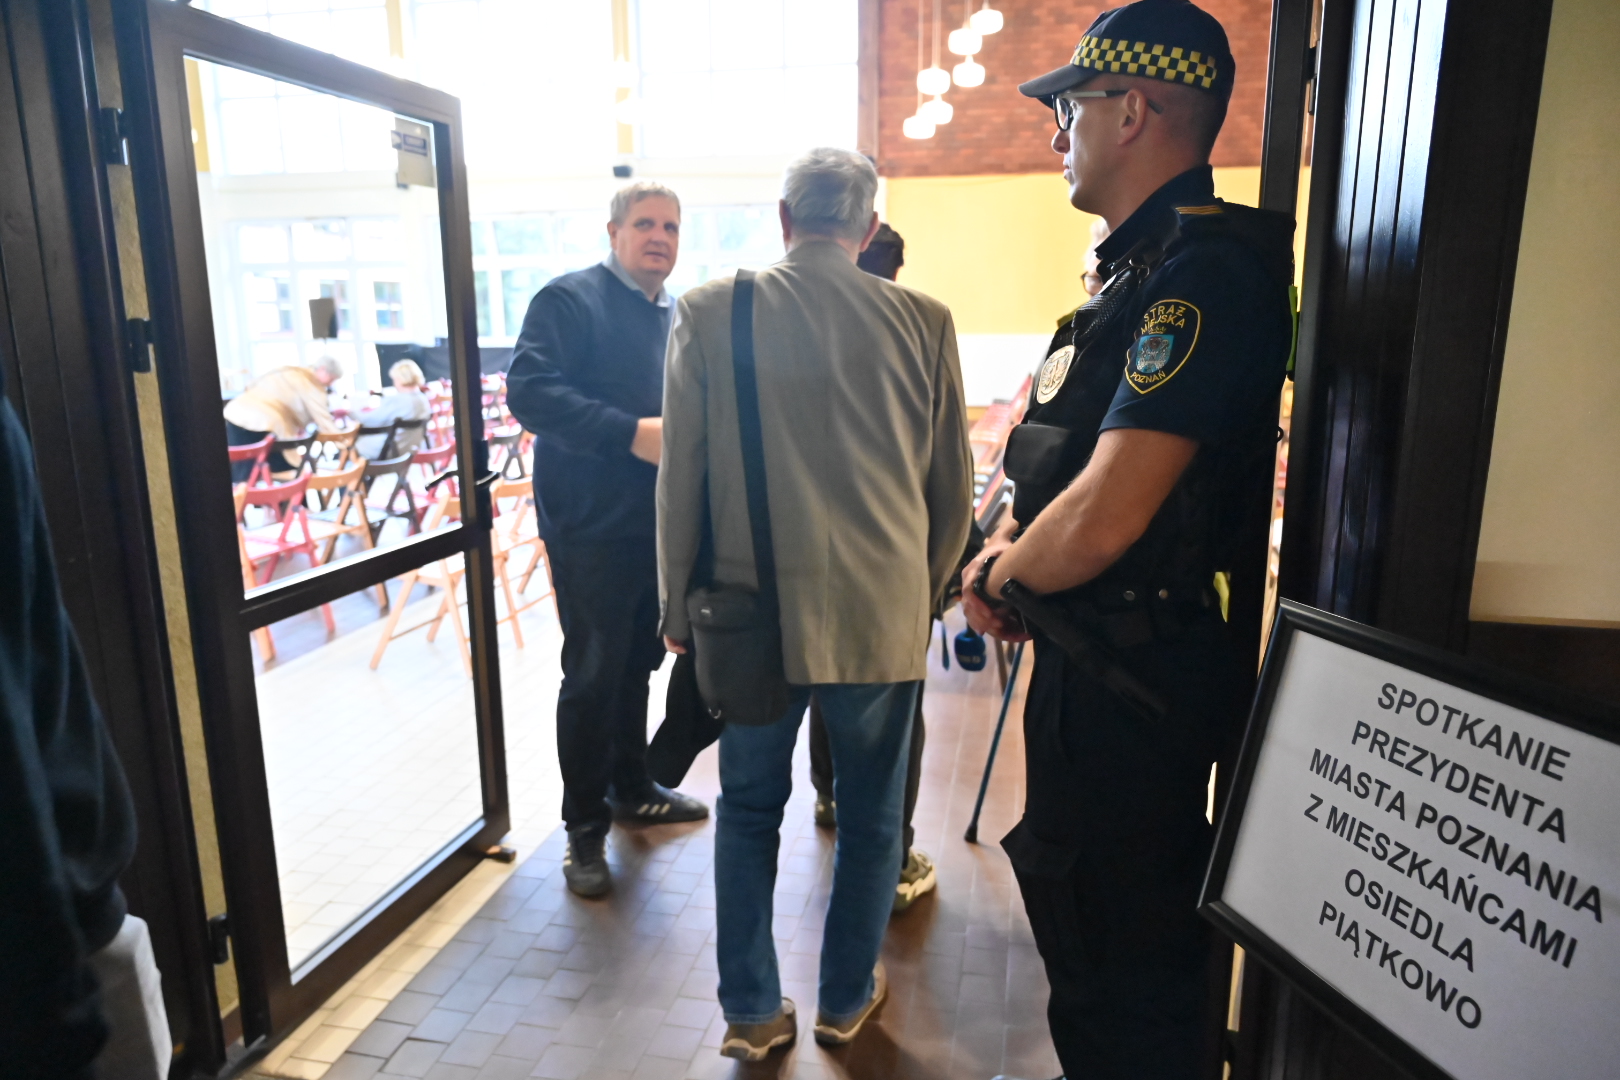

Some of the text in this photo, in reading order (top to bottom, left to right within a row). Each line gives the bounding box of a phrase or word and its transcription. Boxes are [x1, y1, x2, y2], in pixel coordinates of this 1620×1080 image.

[1140, 314, 1186, 335] MIEJSKA
[1351, 720, 1566, 844] PREZYDENTA
[1377, 682, 1572, 782] SPOTKANIE
[1303, 793, 1579, 970] Z MIESZKAŃCAMI
[1309, 748, 1604, 924] MIASTA POZNANIA
[1318, 900, 1482, 1030] PIĄTKOWO
[1344, 868, 1474, 973] OSIEDLA
